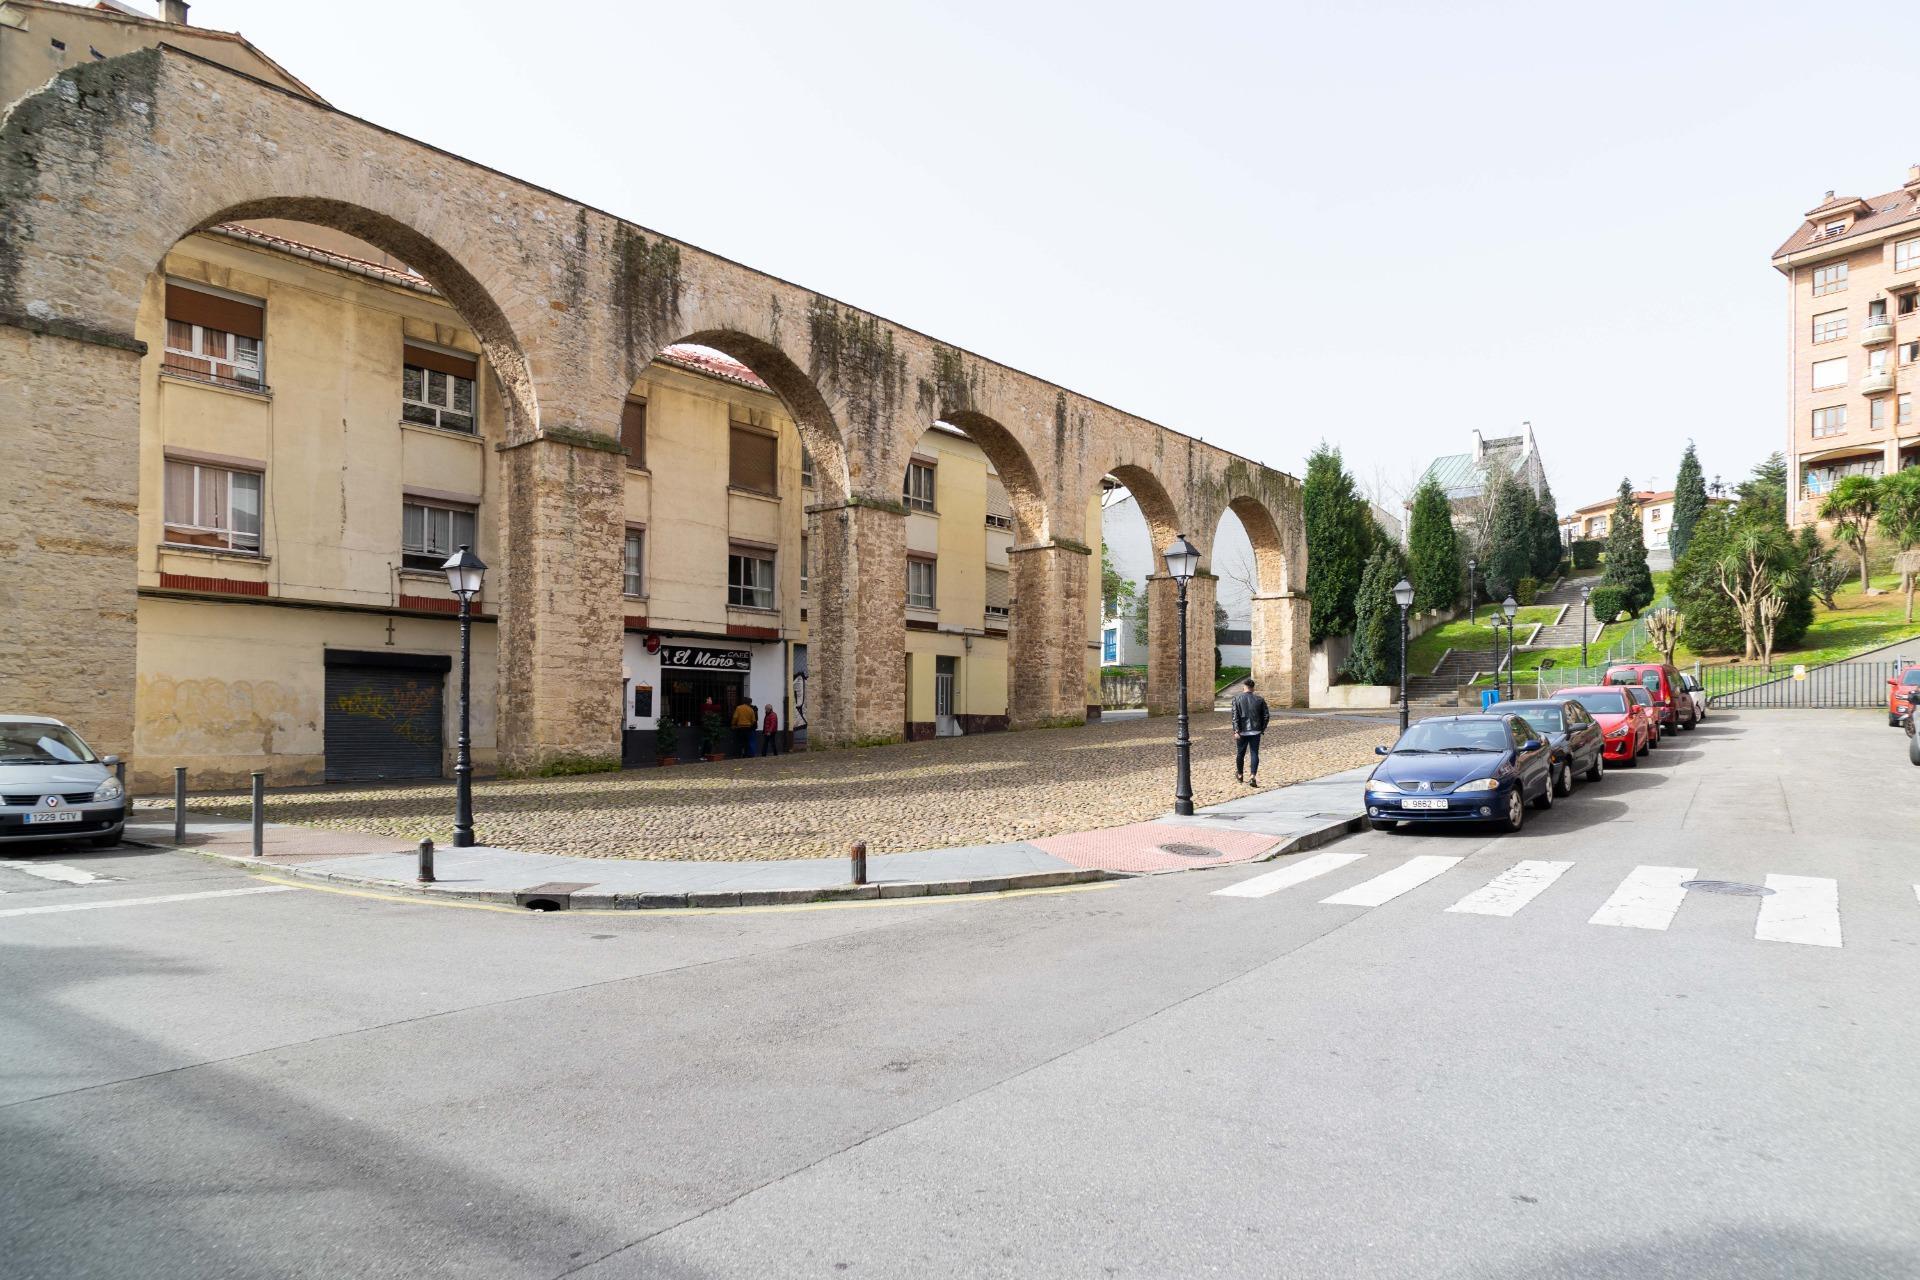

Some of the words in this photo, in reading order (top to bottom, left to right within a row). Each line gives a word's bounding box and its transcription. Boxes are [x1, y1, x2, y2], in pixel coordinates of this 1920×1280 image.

[673, 649, 691, 664] El
[694, 651, 734, 667] Maño
[33, 812, 56, 822] 1229
[59, 811, 77, 821] CTV
